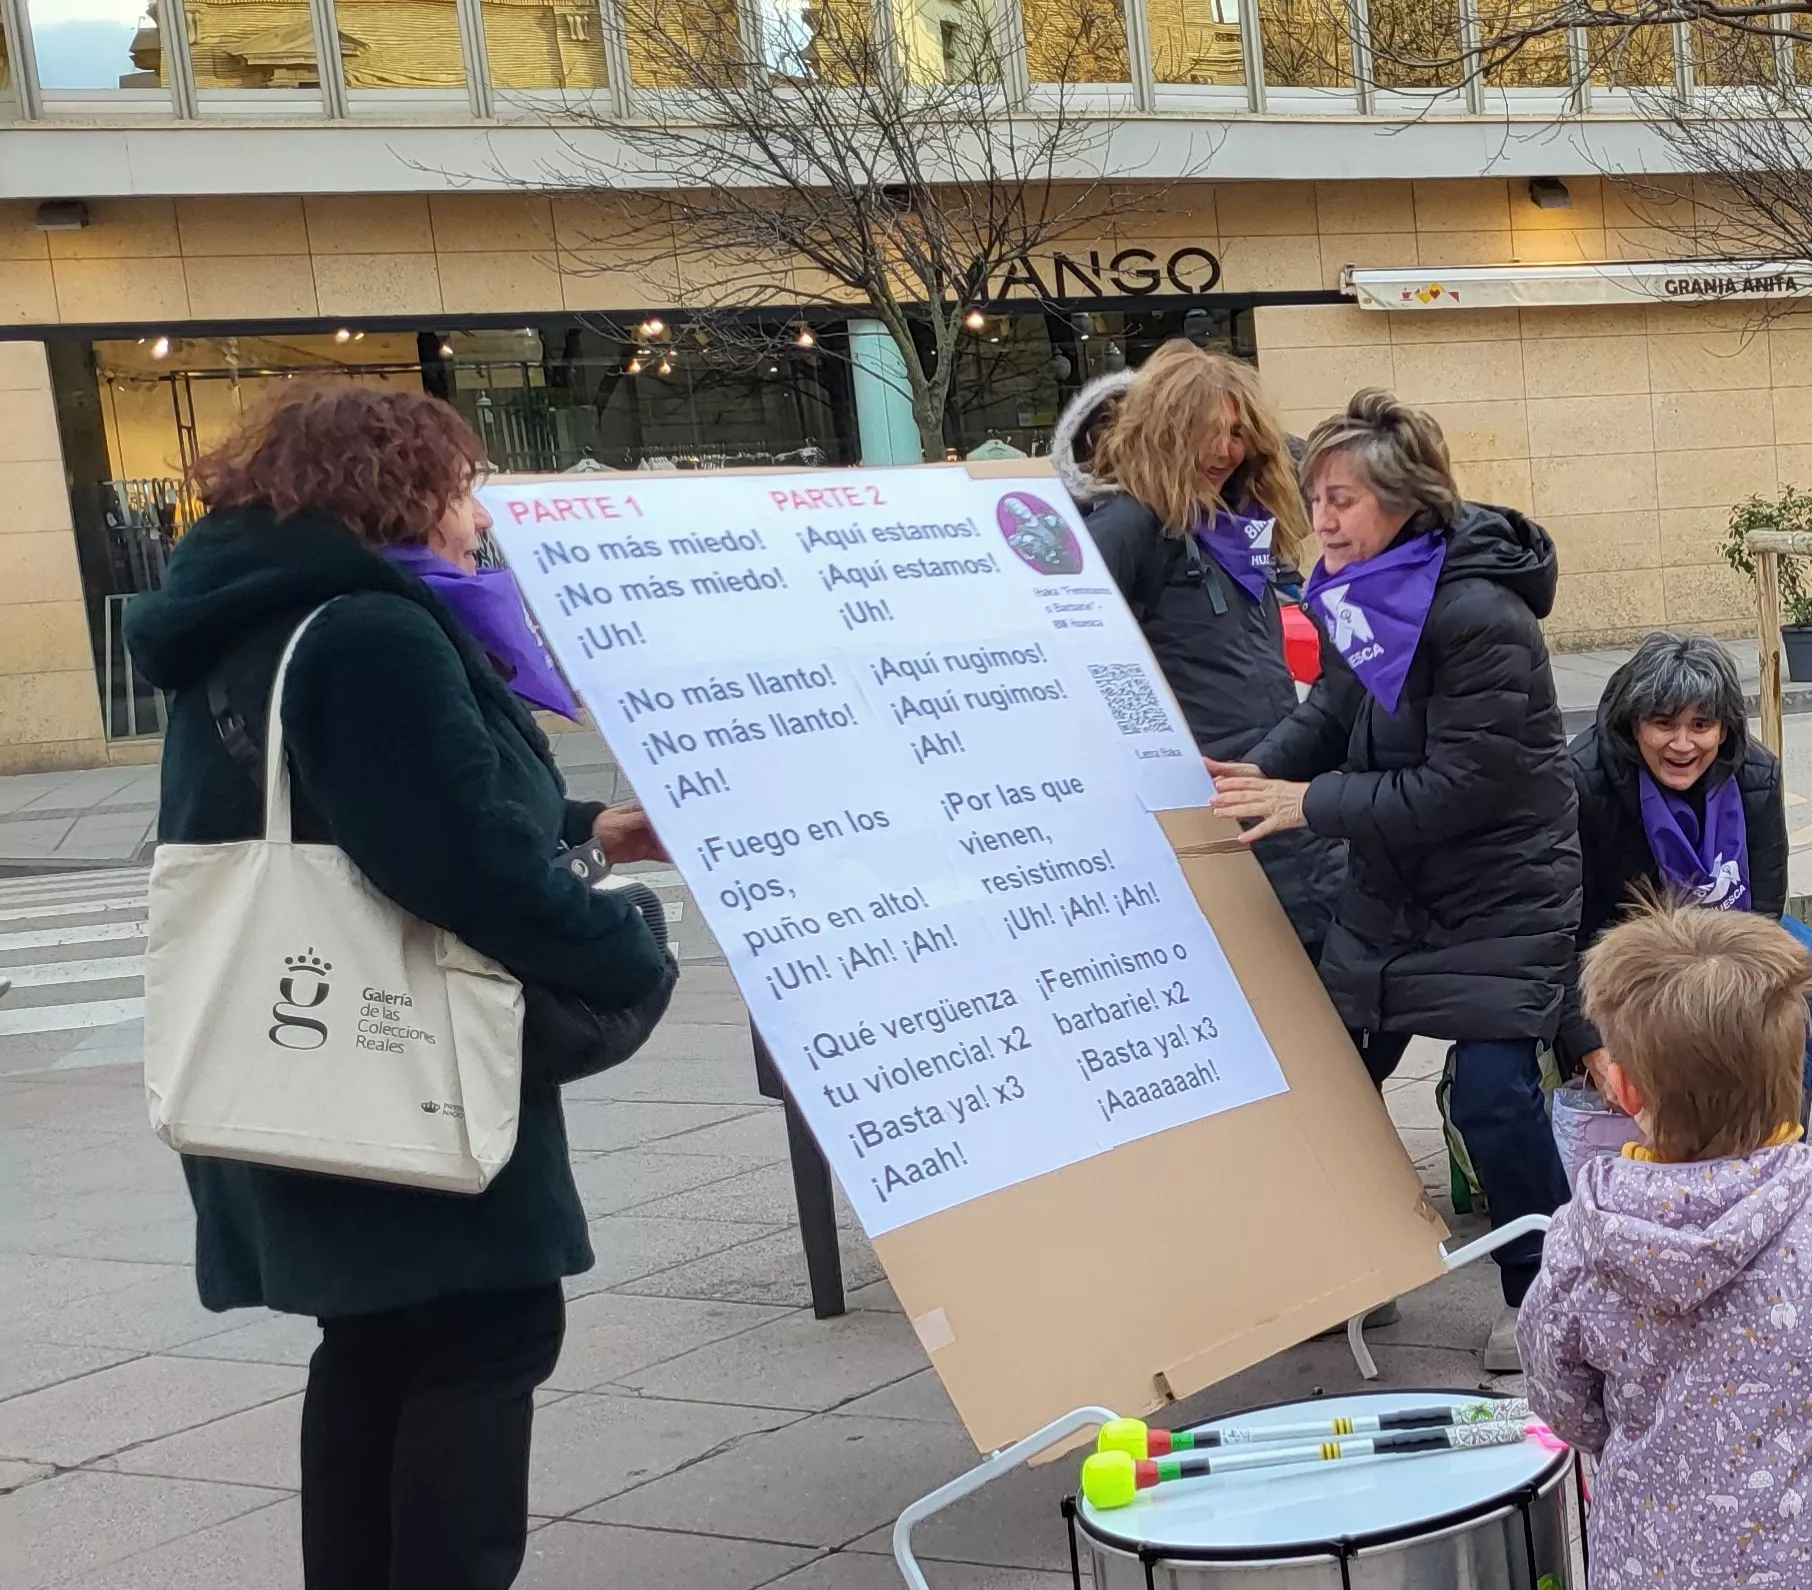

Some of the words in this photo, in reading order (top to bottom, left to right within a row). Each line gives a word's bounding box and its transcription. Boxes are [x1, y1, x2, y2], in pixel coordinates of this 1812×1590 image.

[1742, 275, 1799, 293] ANITA
[506, 495, 623, 526] PARTE
[624, 494, 645, 519] 1
[768, 486, 866, 512] PARTE
[864, 485, 888, 506] 2
[532, 540, 590, 575] ¡No
[597, 535, 663, 561] más
[667, 528, 767, 556] miedo!
[797, 520, 868, 554] ¡Aquí
[871, 516, 981, 543] estamos!
[555, 582, 613, 617] ¡No
[619, 575, 686, 602] más
[690, 566, 788, 596] miedo!
[819, 557, 890, 592] ¡Aquí
[891, 551, 1001, 580] estamos!
[839, 598, 894, 631] ¡Uh!
[576, 620, 647, 660] ¡Uh!
[1347, 643, 1385, 669] ESCA
[870, 651, 941, 687] ¡Aquí
[942, 642, 1048, 675] rugimos!
[617, 687, 675, 724] ¡No
[681, 676, 745, 706] más
[745, 663, 838, 696] llanto!
[889, 688, 961, 726] ¡Aquí
[963, 678, 1065, 712] rugimos!
[640, 729, 698, 766] ¡No
[702, 717, 767, 748] más
[767, 702, 858, 737] llanto!
[910, 729, 966, 765] ¡Ah!
[664, 767, 731, 809] ¡Ah!
[939, 791, 993, 822] ¡Por
[995, 783, 1037, 807] las
[1040, 777, 1085, 803] que
[697, 828, 801, 872] ¡Fuego
[807, 819, 844, 841] en
[843, 809, 891, 834] los
[958, 825, 1054, 856] vienen,
[719, 878, 796, 912] ojos,
[979, 848, 1116, 896] resistimos!
[741, 914, 821, 958] puño
[826, 906, 866, 929] en
[867, 886, 930, 919] alto!
[1003, 902, 1057, 940] ¡Uh!
[1059, 890, 1108, 928] ¡Ah!
[1112, 880, 1158, 917] ¡Ah!
[764, 954, 833, 1001] ¡Uh!
[836, 937, 899, 981] ¡Ah!
[901, 923, 959, 964] ¡Ah!
[1034, 948, 1169, 1002] ¡Feminismo
[1171, 943, 1188, 961] o
[360, 1003, 380, 1018] de
[382, 1005, 400, 1021] las
[362, 987, 413, 1007] Galería
[1051, 987, 1161, 1036] barbarie!
[1159, 980, 1191, 1007] x2
[356, 1034, 405, 1055] Reales
[802, 1020, 878, 1072] ¡Qué
[879, 988, 1019, 1042] vergüenza
[1075, 1038, 1154, 1081] ¡Basta
[1151, 1023, 1191, 1059] ya!
[1190, 1016, 1219, 1043] x3
[822, 1082, 861, 1108] tu
[864, 1036, 997, 1094] violencia!
[996, 1025, 1033, 1055] x2
[847, 1104, 946, 1159] ¡Basta
[946, 1084, 991, 1125] ya!
[991, 1074, 1025, 1105] x3
[870, 1140, 970, 1204] ¡Aaah!
